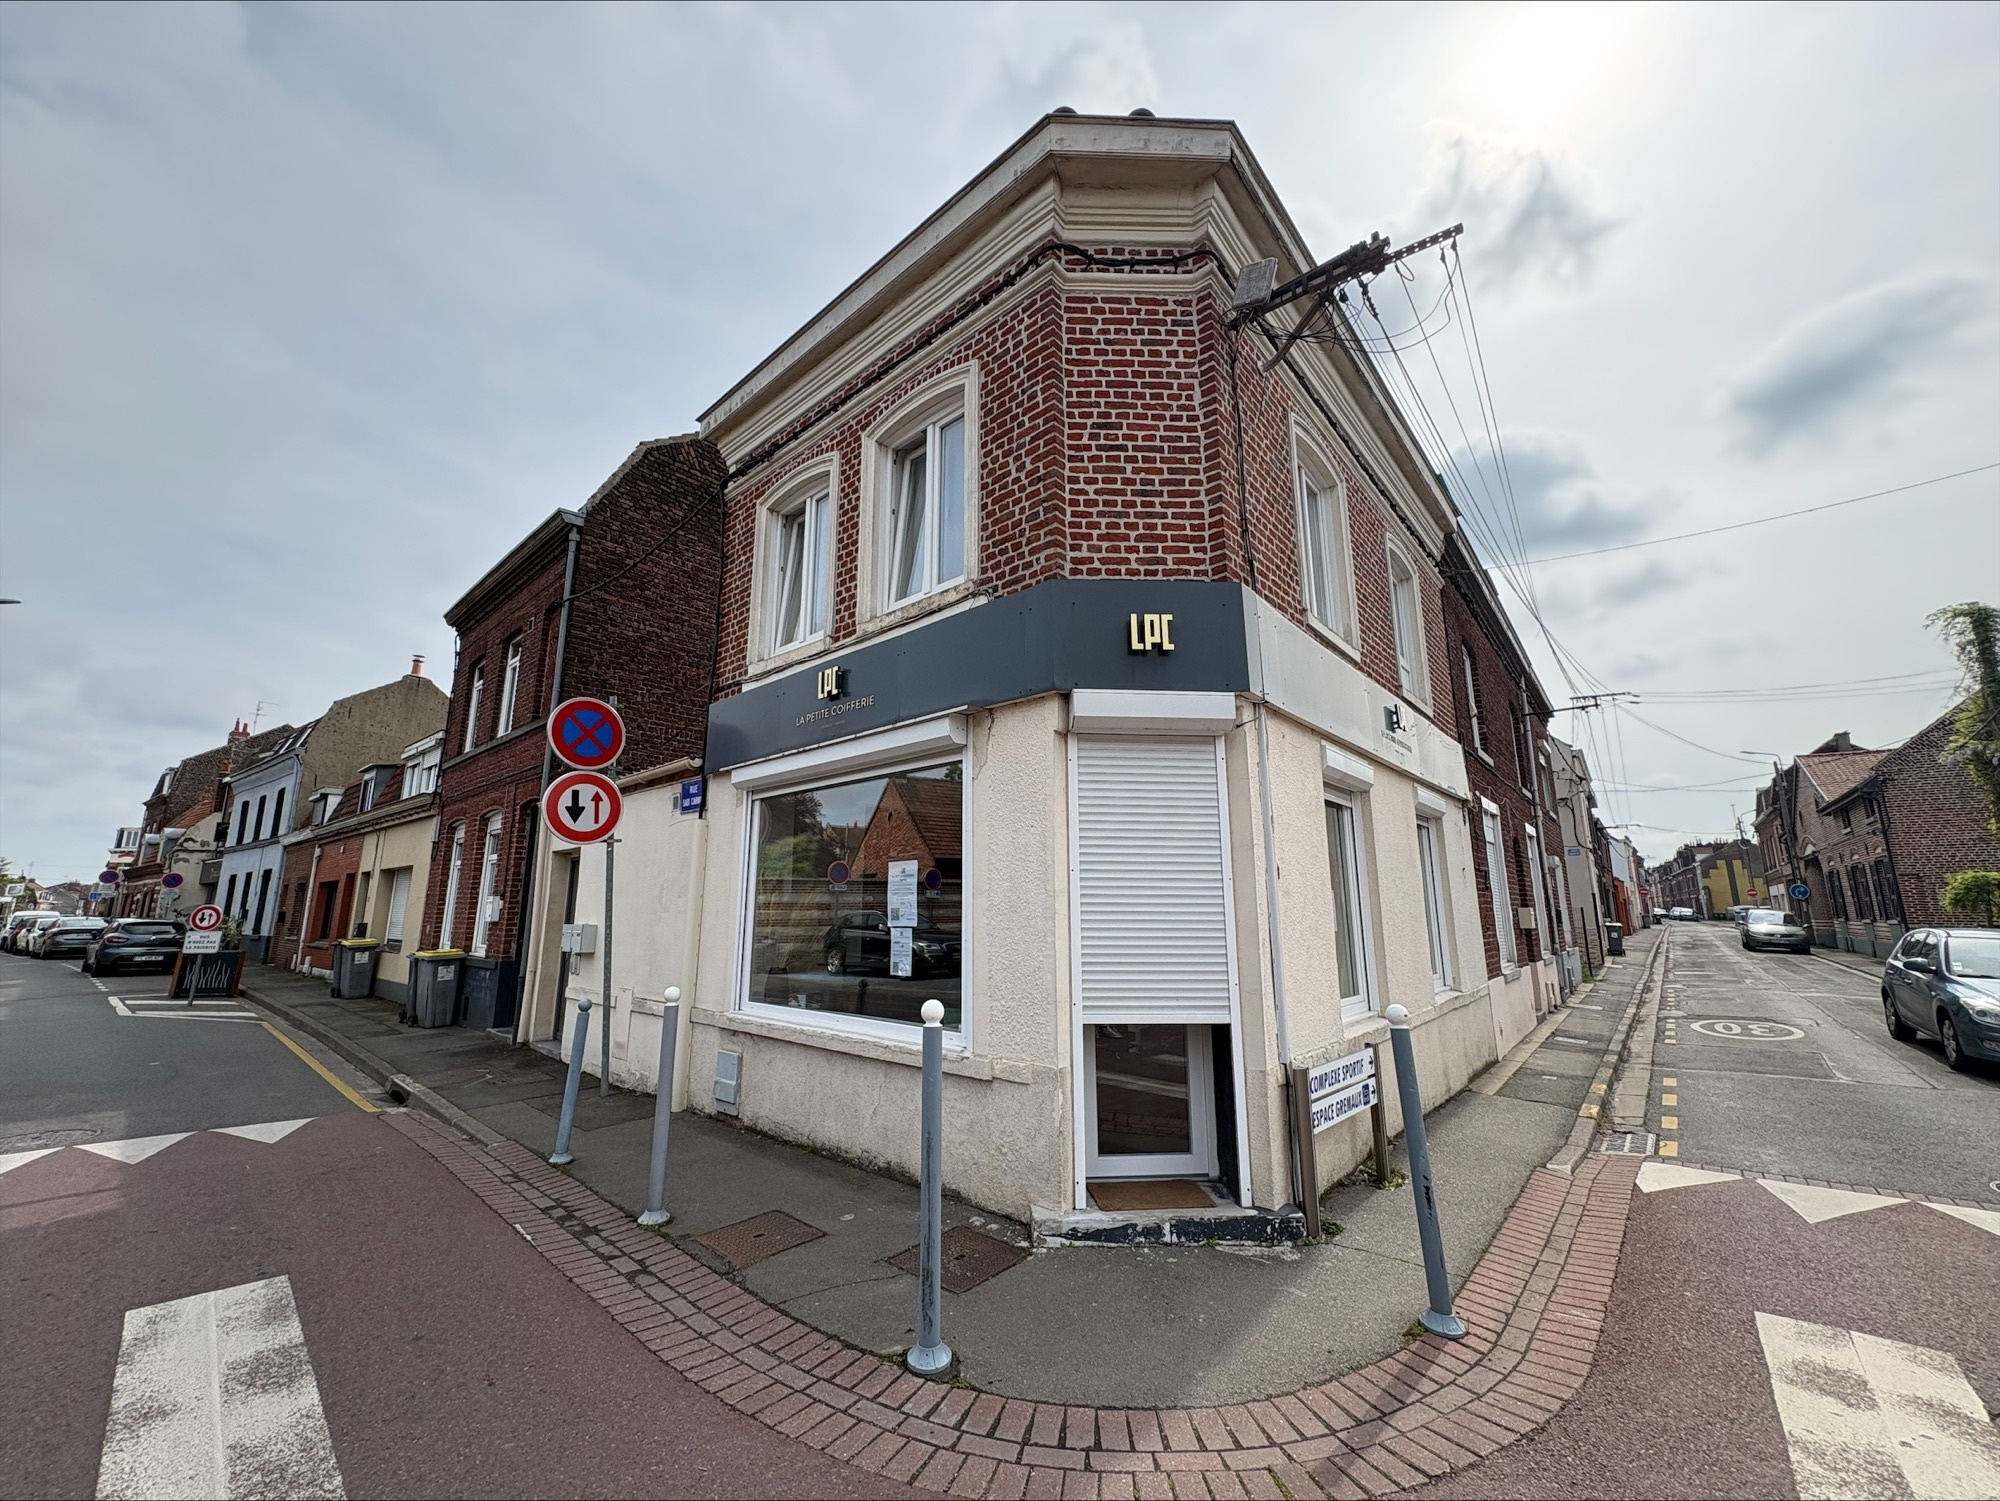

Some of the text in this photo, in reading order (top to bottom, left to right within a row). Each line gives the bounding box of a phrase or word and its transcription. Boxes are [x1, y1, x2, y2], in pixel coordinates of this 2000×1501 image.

[1130, 613, 1175, 651] LPC
[817, 665, 839, 700] LPC
[796, 716, 805, 727] LA
[806, 708, 830, 723] PETITE
[831, 695, 875, 716] COIFFERIE
[690, 785, 698, 794] RUE
[1714, 1022, 1775, 1036] 30
[1310, 1059, 1363, 1094] COMPLEXE SPORTIF
[1312, 1090, 1363, 1129] ESPACE GREMAUX
